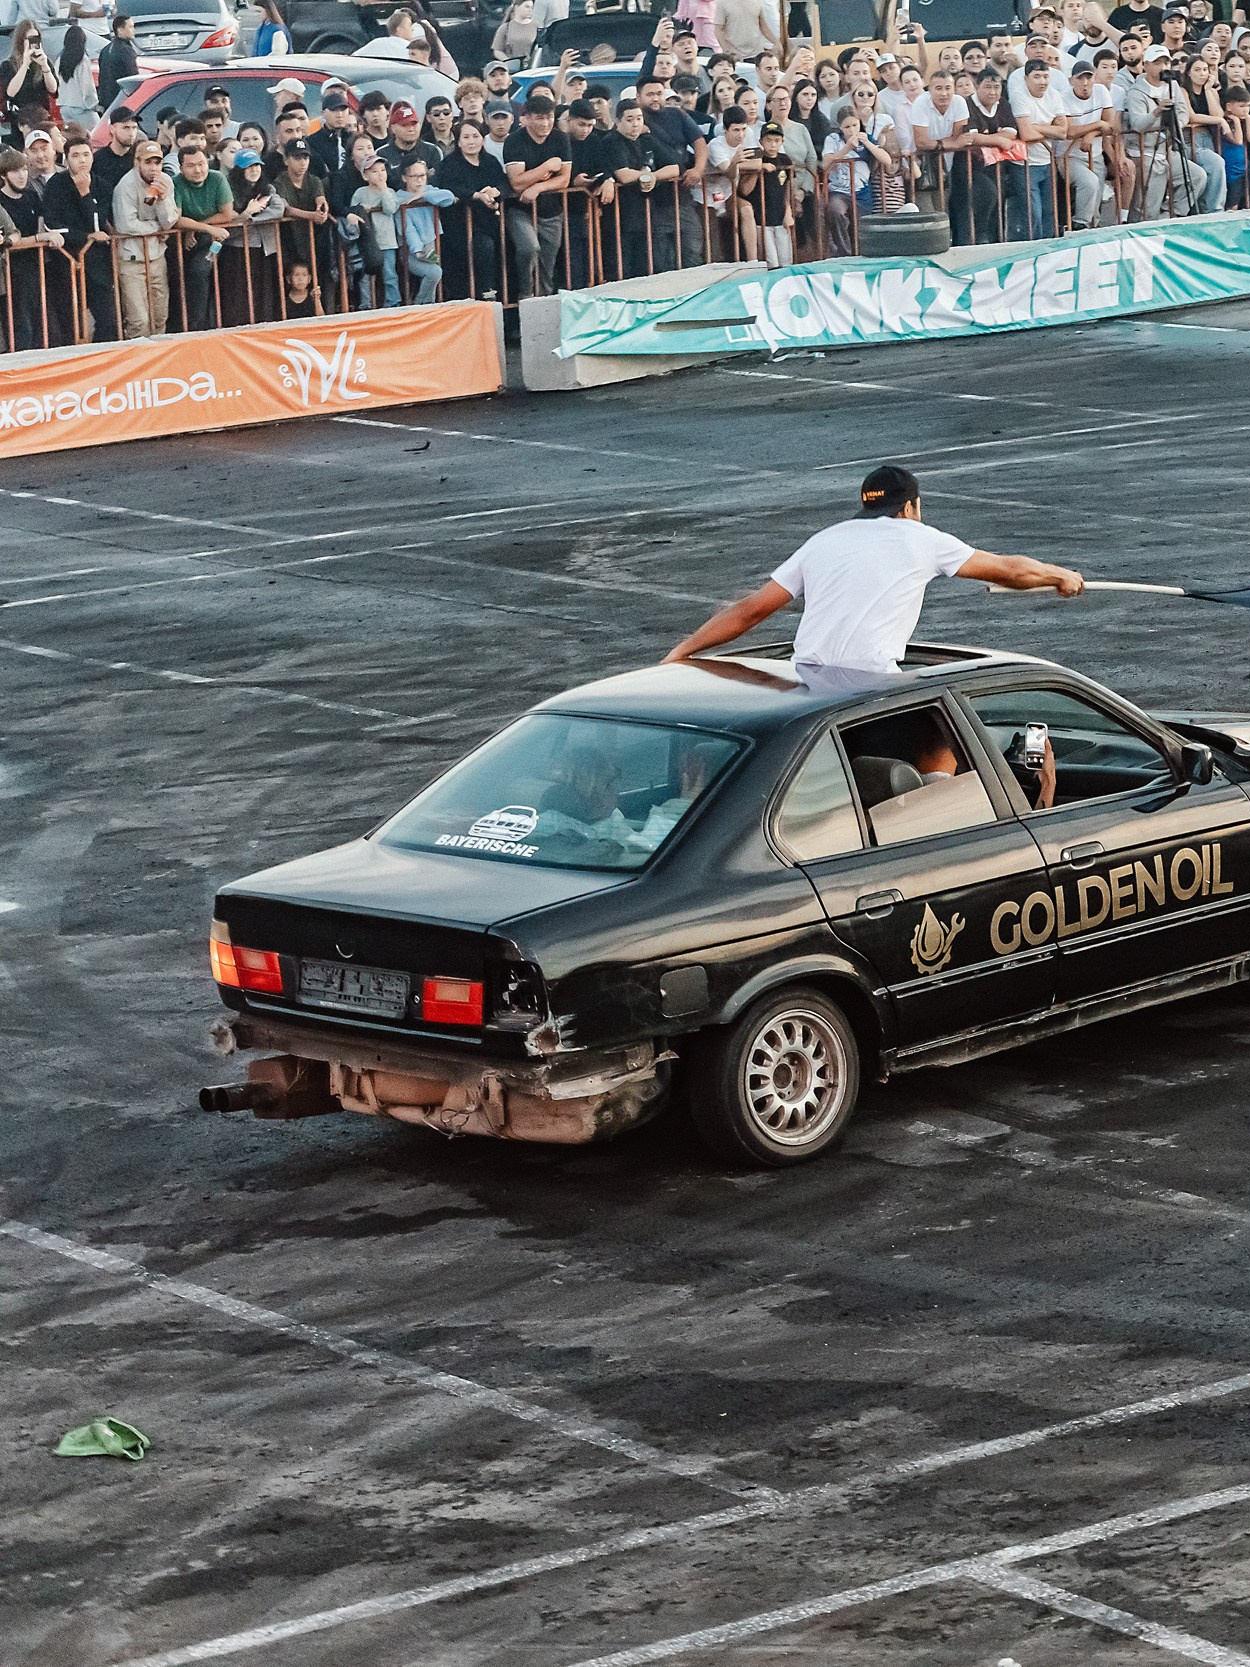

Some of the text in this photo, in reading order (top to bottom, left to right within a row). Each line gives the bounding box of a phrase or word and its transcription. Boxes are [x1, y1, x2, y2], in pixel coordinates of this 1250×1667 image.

[435, 834, 540, 858] BAYERISCHE
[990, 843, 1234, 955] GOLDEN OIL
